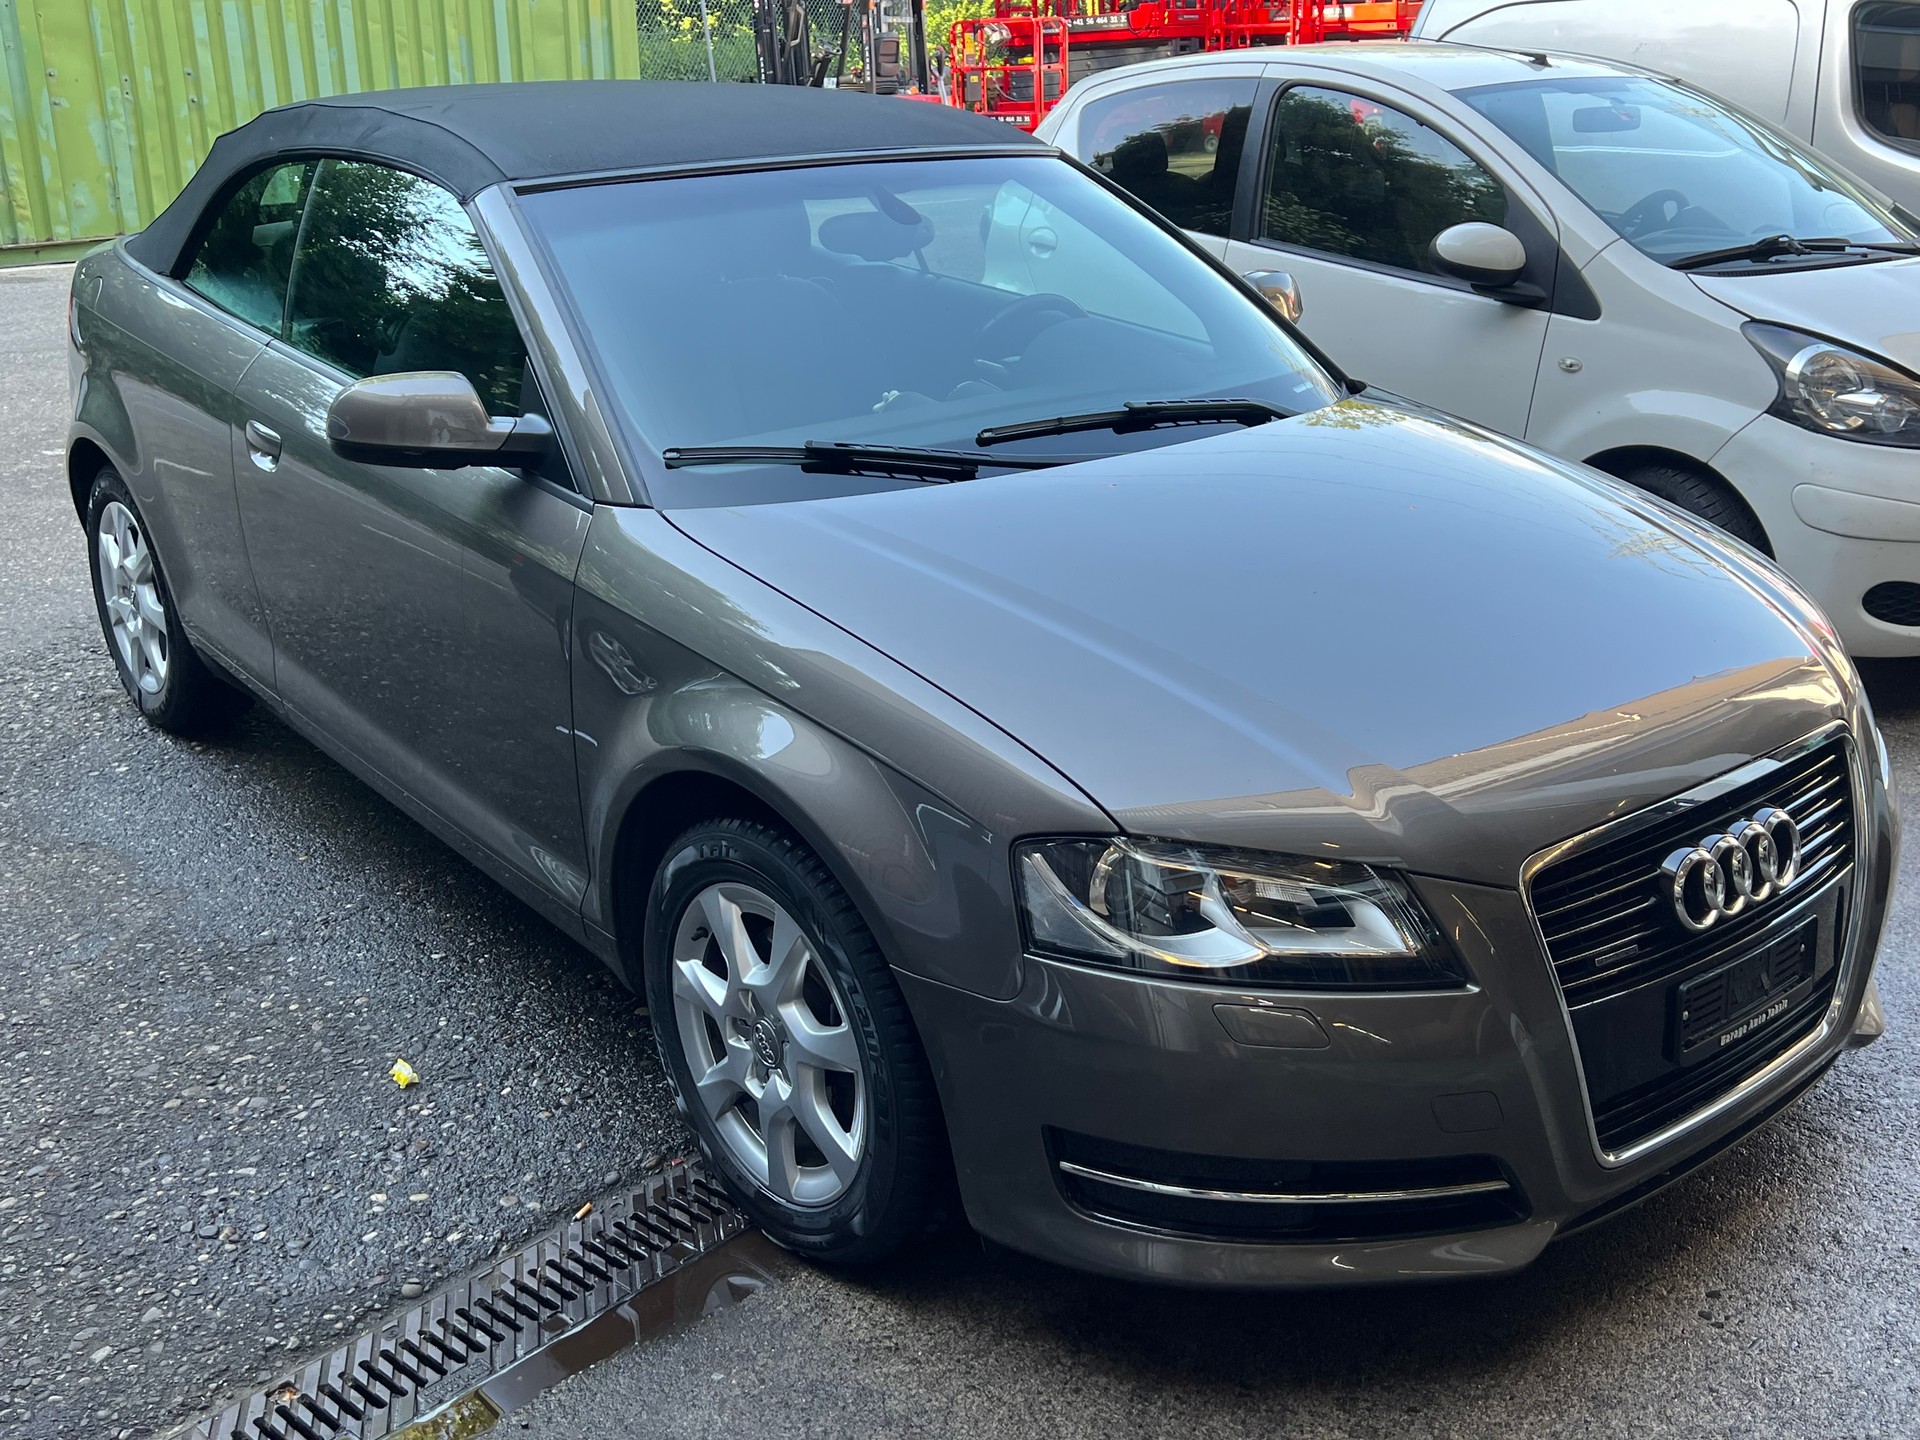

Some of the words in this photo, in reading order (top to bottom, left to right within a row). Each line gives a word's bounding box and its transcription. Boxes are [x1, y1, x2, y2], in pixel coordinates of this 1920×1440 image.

[1085, 17, 1095, 25] 56
[1096, 16, 1108, 24] 464
[1720, 1024, 1748, 1046] Garage
[1748, 1013, 1766, 1031] Auto
